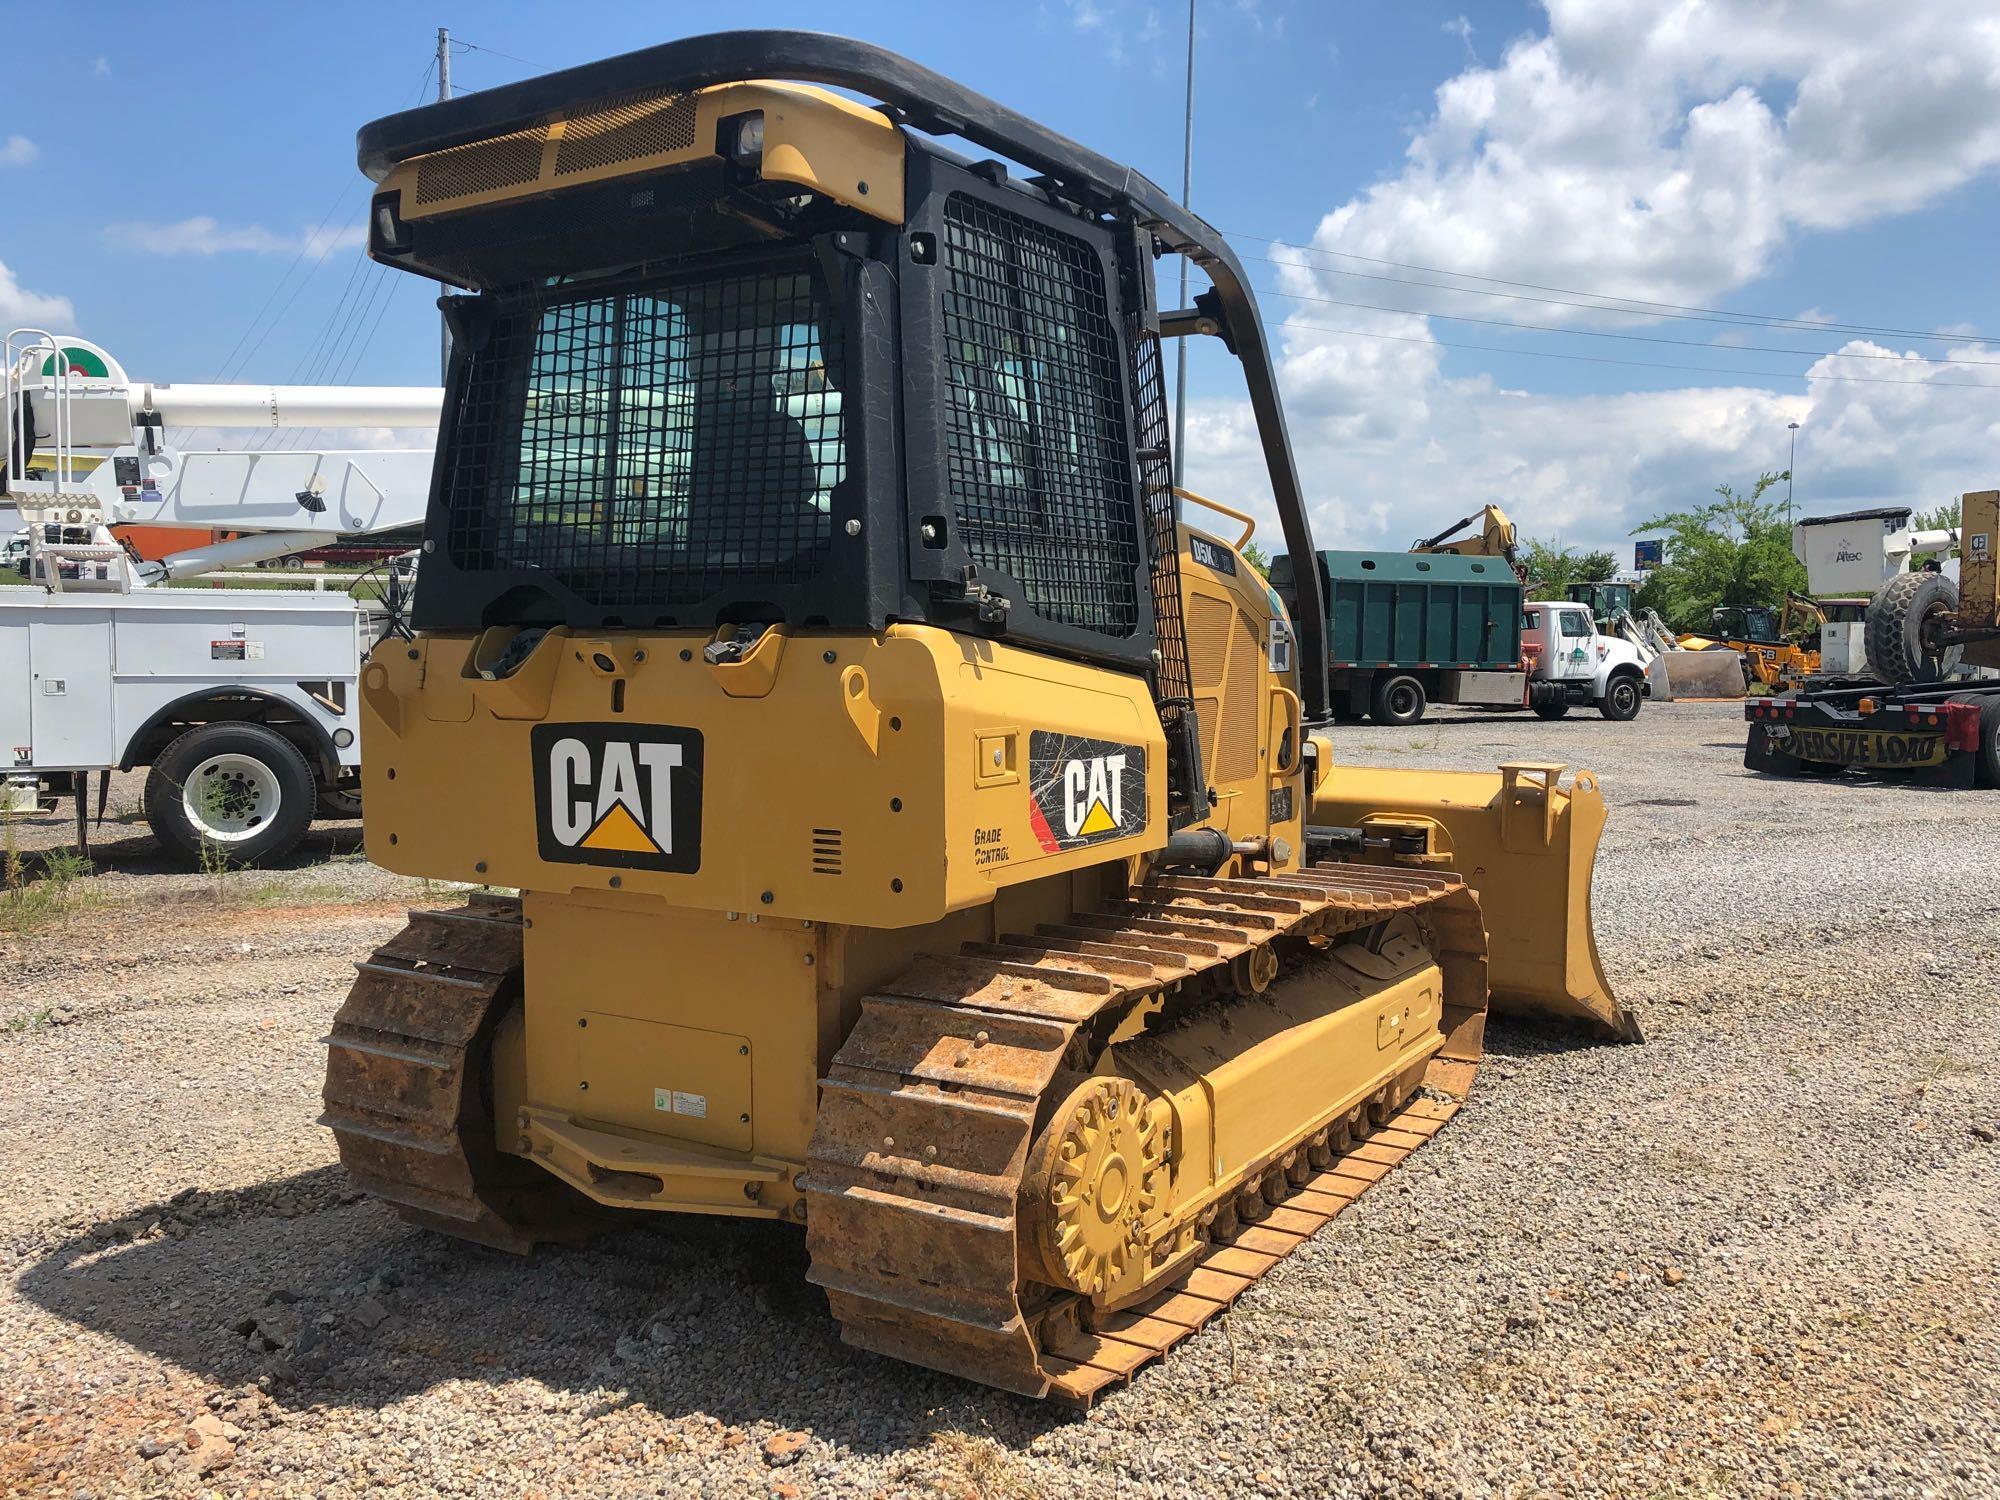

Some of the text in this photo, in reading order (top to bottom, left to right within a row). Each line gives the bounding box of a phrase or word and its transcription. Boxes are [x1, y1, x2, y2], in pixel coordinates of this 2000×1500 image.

[1836, 551, 1863, 563] Altec
[1875, 734, 1937, 764] LOAD
[550, 738, 683, 854] CAT
[1064, 754, 1126, 837] CAT
[974, 828, 1002, 845] GRADE
[974, 846, 1010, 865] CONTROL
